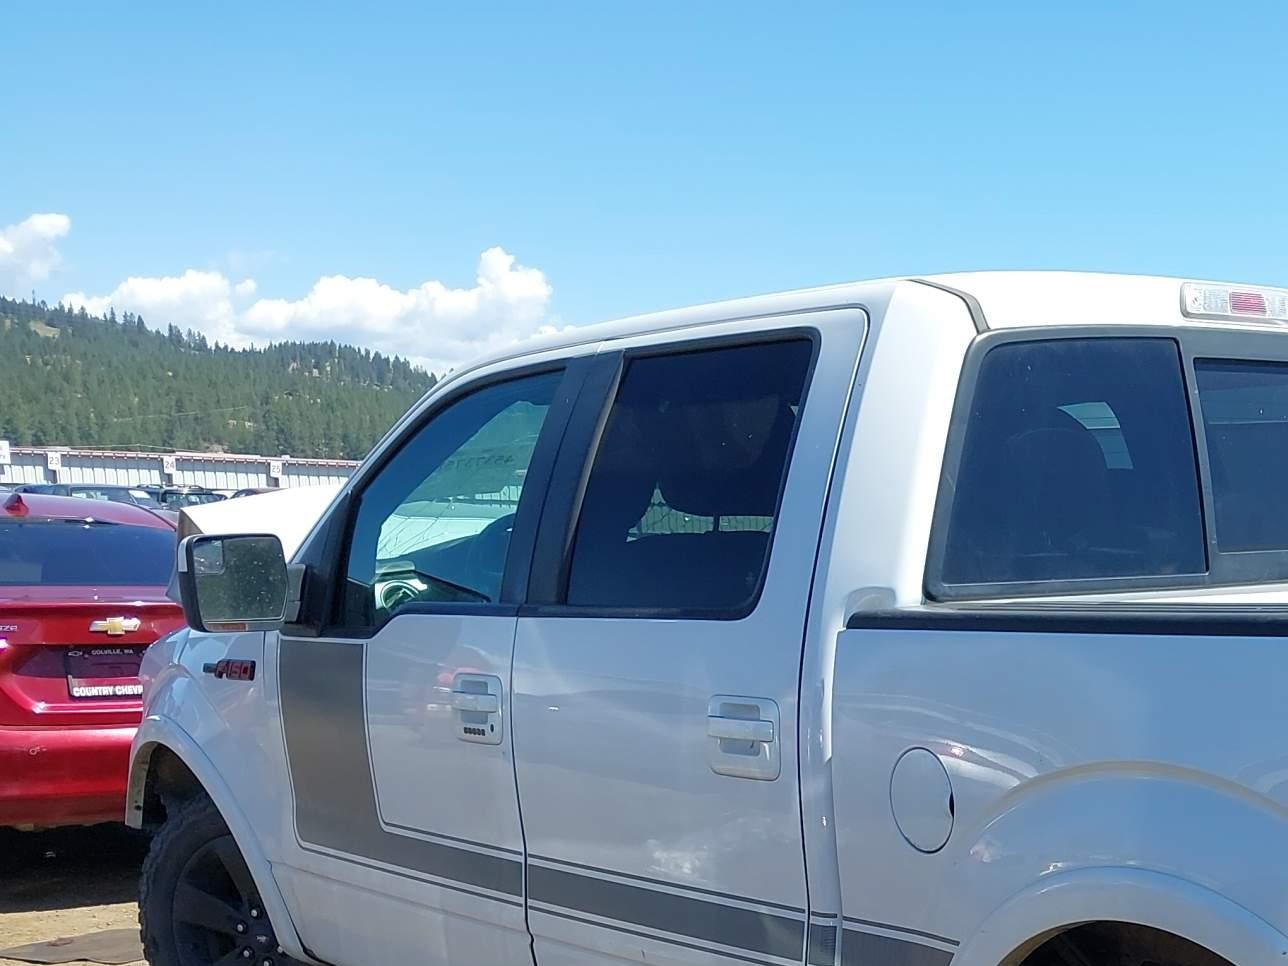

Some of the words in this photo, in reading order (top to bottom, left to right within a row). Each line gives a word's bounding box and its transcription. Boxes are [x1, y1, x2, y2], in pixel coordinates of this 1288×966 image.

[49, 456, 60, 466] 23
[165, 460, 175, 469] 24
[271, 464, 281, 473] 25
[73, 686, 114, 697] COUNTRY
